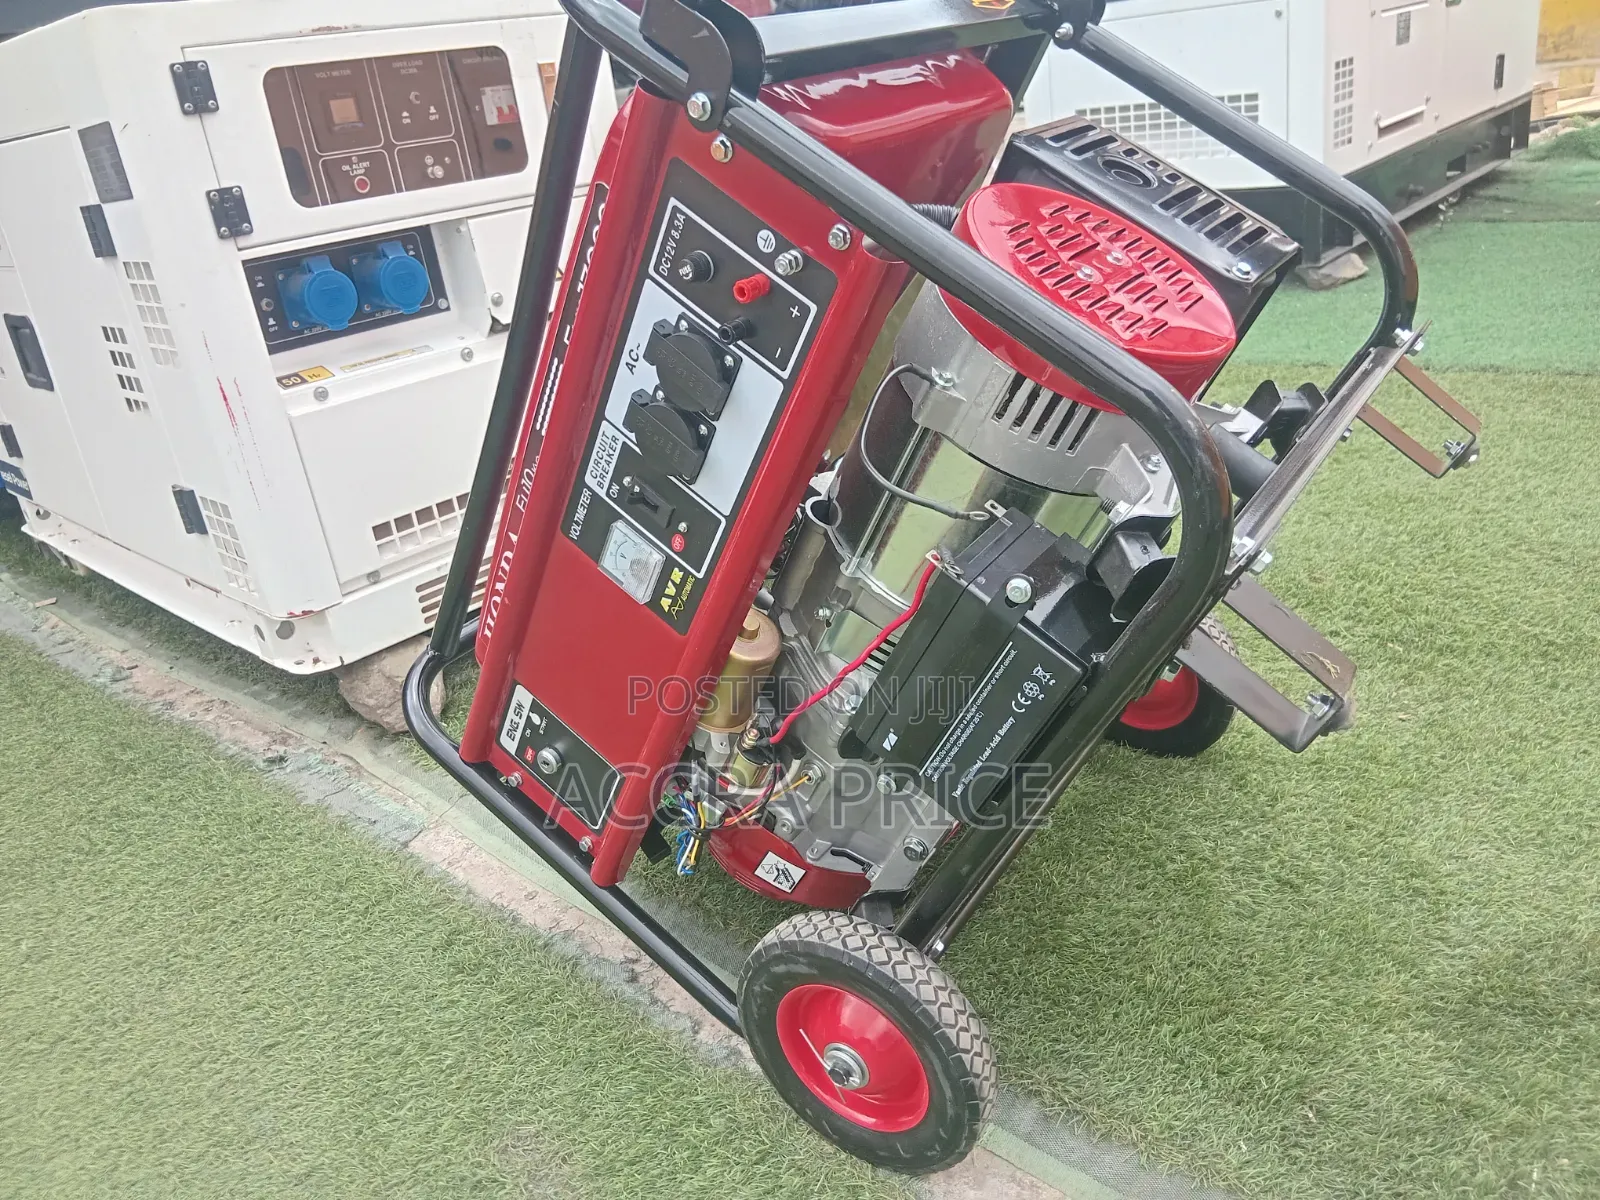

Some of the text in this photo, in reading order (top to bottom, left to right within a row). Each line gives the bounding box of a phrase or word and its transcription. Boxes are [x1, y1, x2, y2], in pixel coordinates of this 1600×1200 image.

[314, 68, 352, 79] VOLT METER
[350, 168, 365, 176] LAMP
[352, 161, 370, 170] ALERT
[659, 211, 686, 277] DC12V 8.3A
[282, 376, 301, 386] 50
[589, 430, 610, 480] CIRCUIT
[596, 435, 620, 490] BREAKER
[609, 482, 620, 499] ON
[568, 487, 593, 541] VOLTMETER
[673, 535, 683, 550] OFF
[660, 567, 685, 613] AVR
[681, 574, 696, 603] AUTOMATIC
[513, 699, 526, 720] SW
[948, 728, 962, 744] charge
[975, 683, 993, 706] container
[995, 664, 1006, 679] short
[979, 734, 1001, 761] Lead-Acid
[998, 715, 1016, 737] Battery
